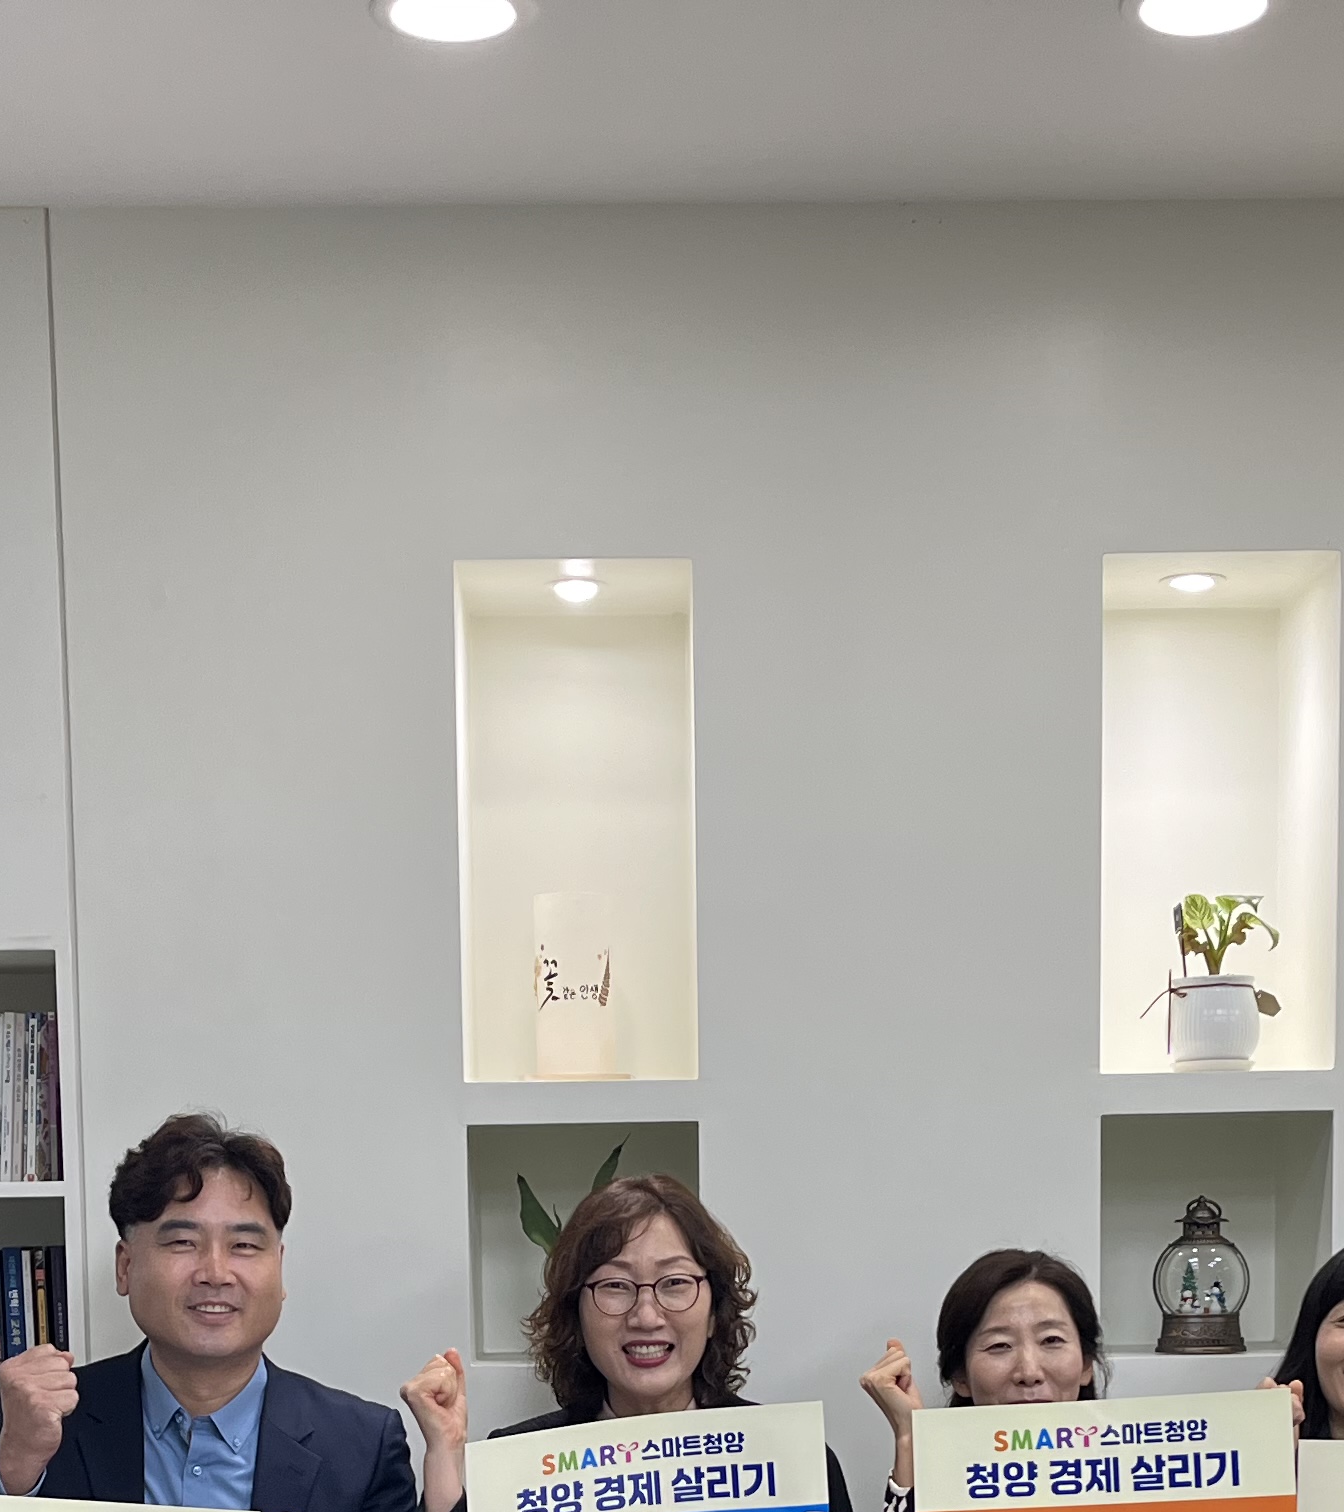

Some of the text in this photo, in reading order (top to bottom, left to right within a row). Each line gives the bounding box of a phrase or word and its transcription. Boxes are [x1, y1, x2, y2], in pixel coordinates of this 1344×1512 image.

[539, 959, 560, 1012] 꽃
[579, 984, 599, 1000] 인생
[641, 1431, 745, 1461] 스마트청양
[1100, 1418, 1207, 1446] 스마트청양
[593, 1469, 662, 1512] 경제
[670, 1461, 777, 1504] 살리기
[965, 1449, 1240, 1499] 청양 경제 살리기
